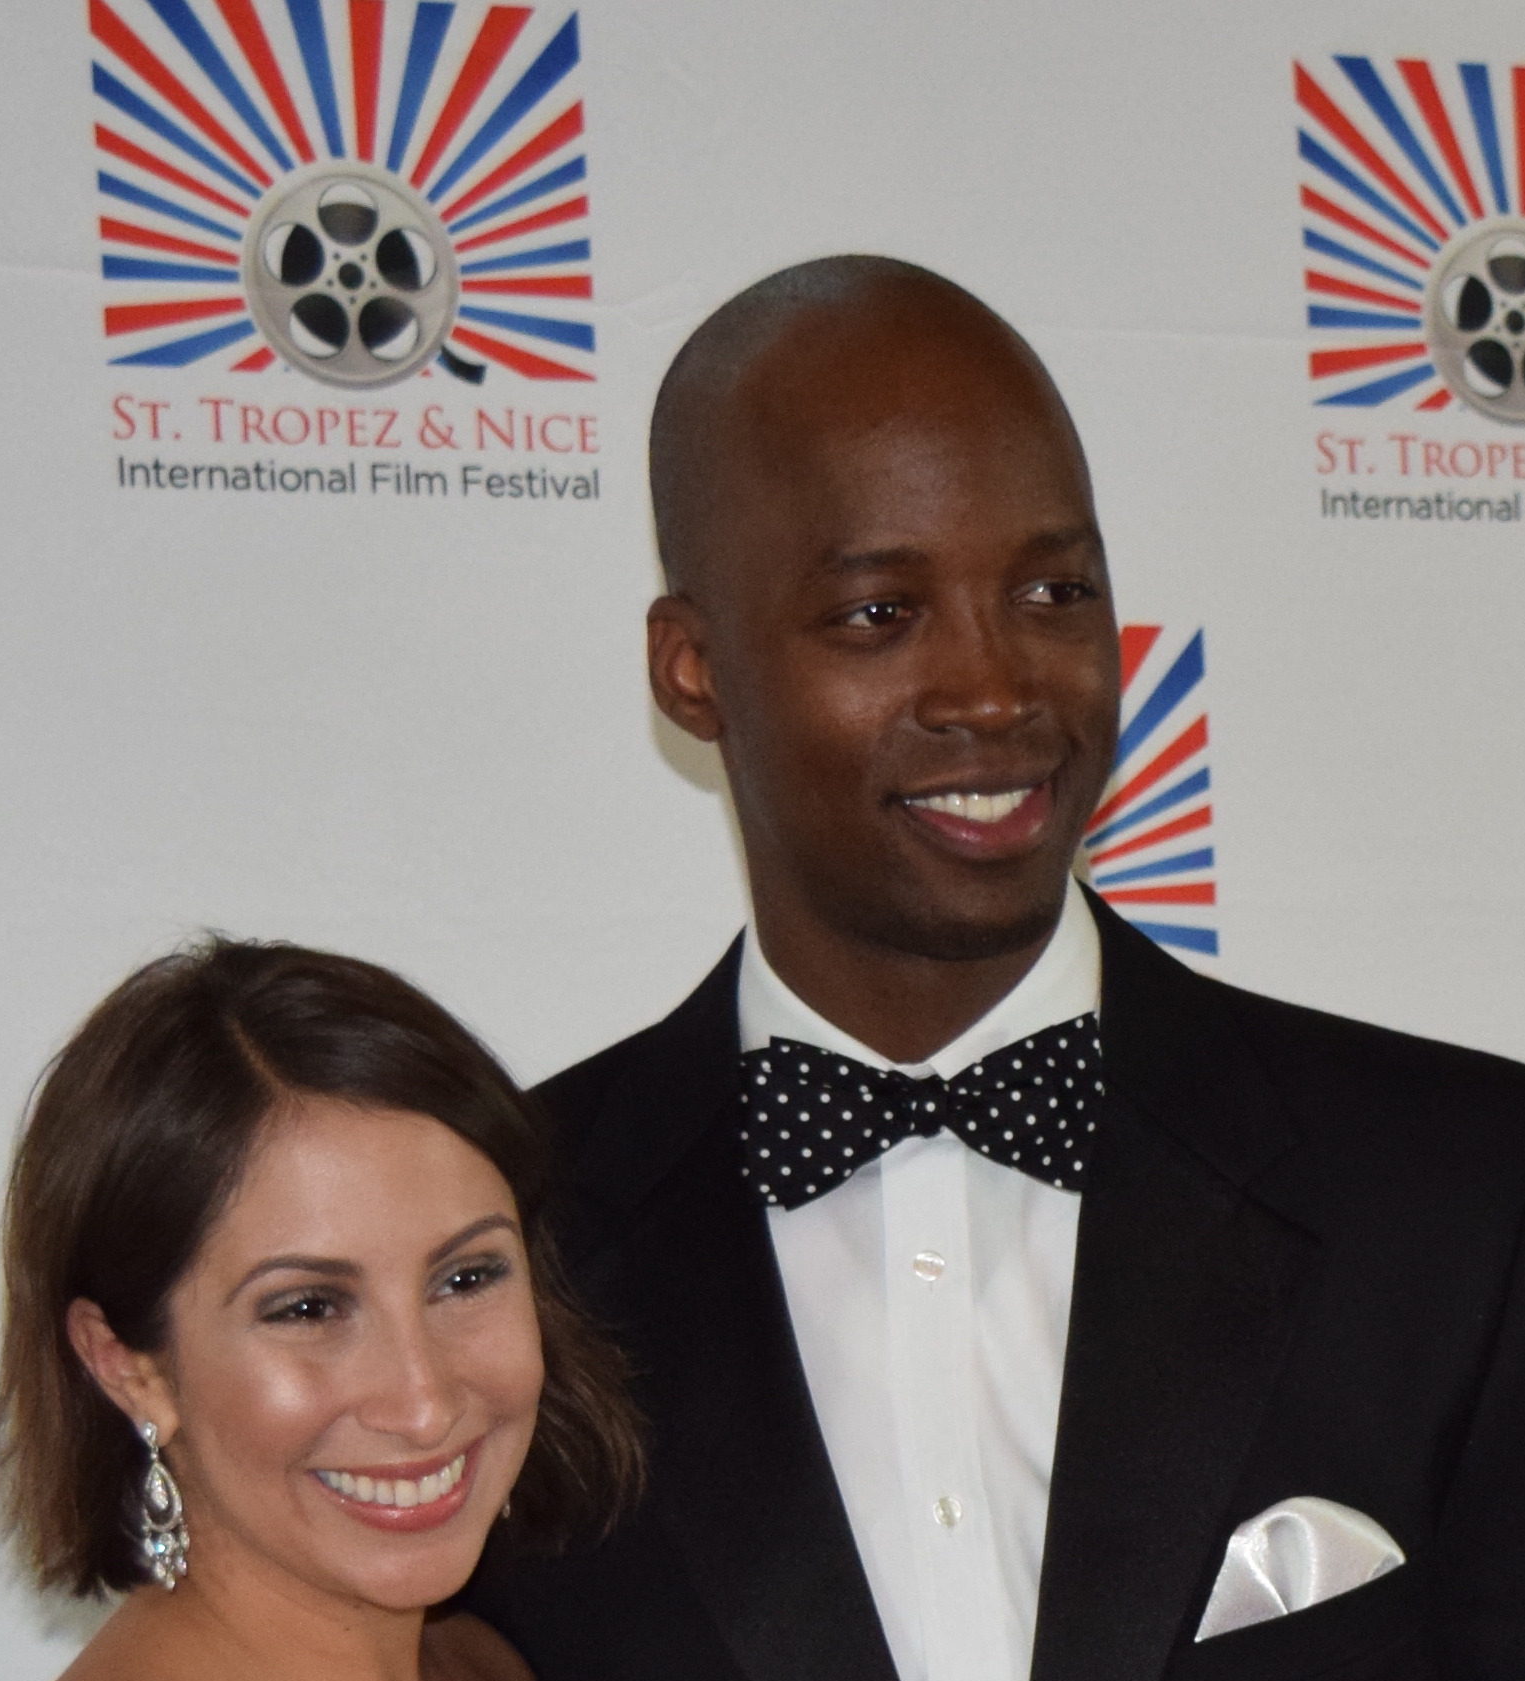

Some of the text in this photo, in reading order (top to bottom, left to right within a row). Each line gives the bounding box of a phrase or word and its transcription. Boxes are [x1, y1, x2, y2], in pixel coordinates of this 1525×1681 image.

[111, 394, 598, 454] ST. TROPEZ & NICE
[118, 456, 599, 500] International Film Festival
[1321, 489, 1522, 522] International
